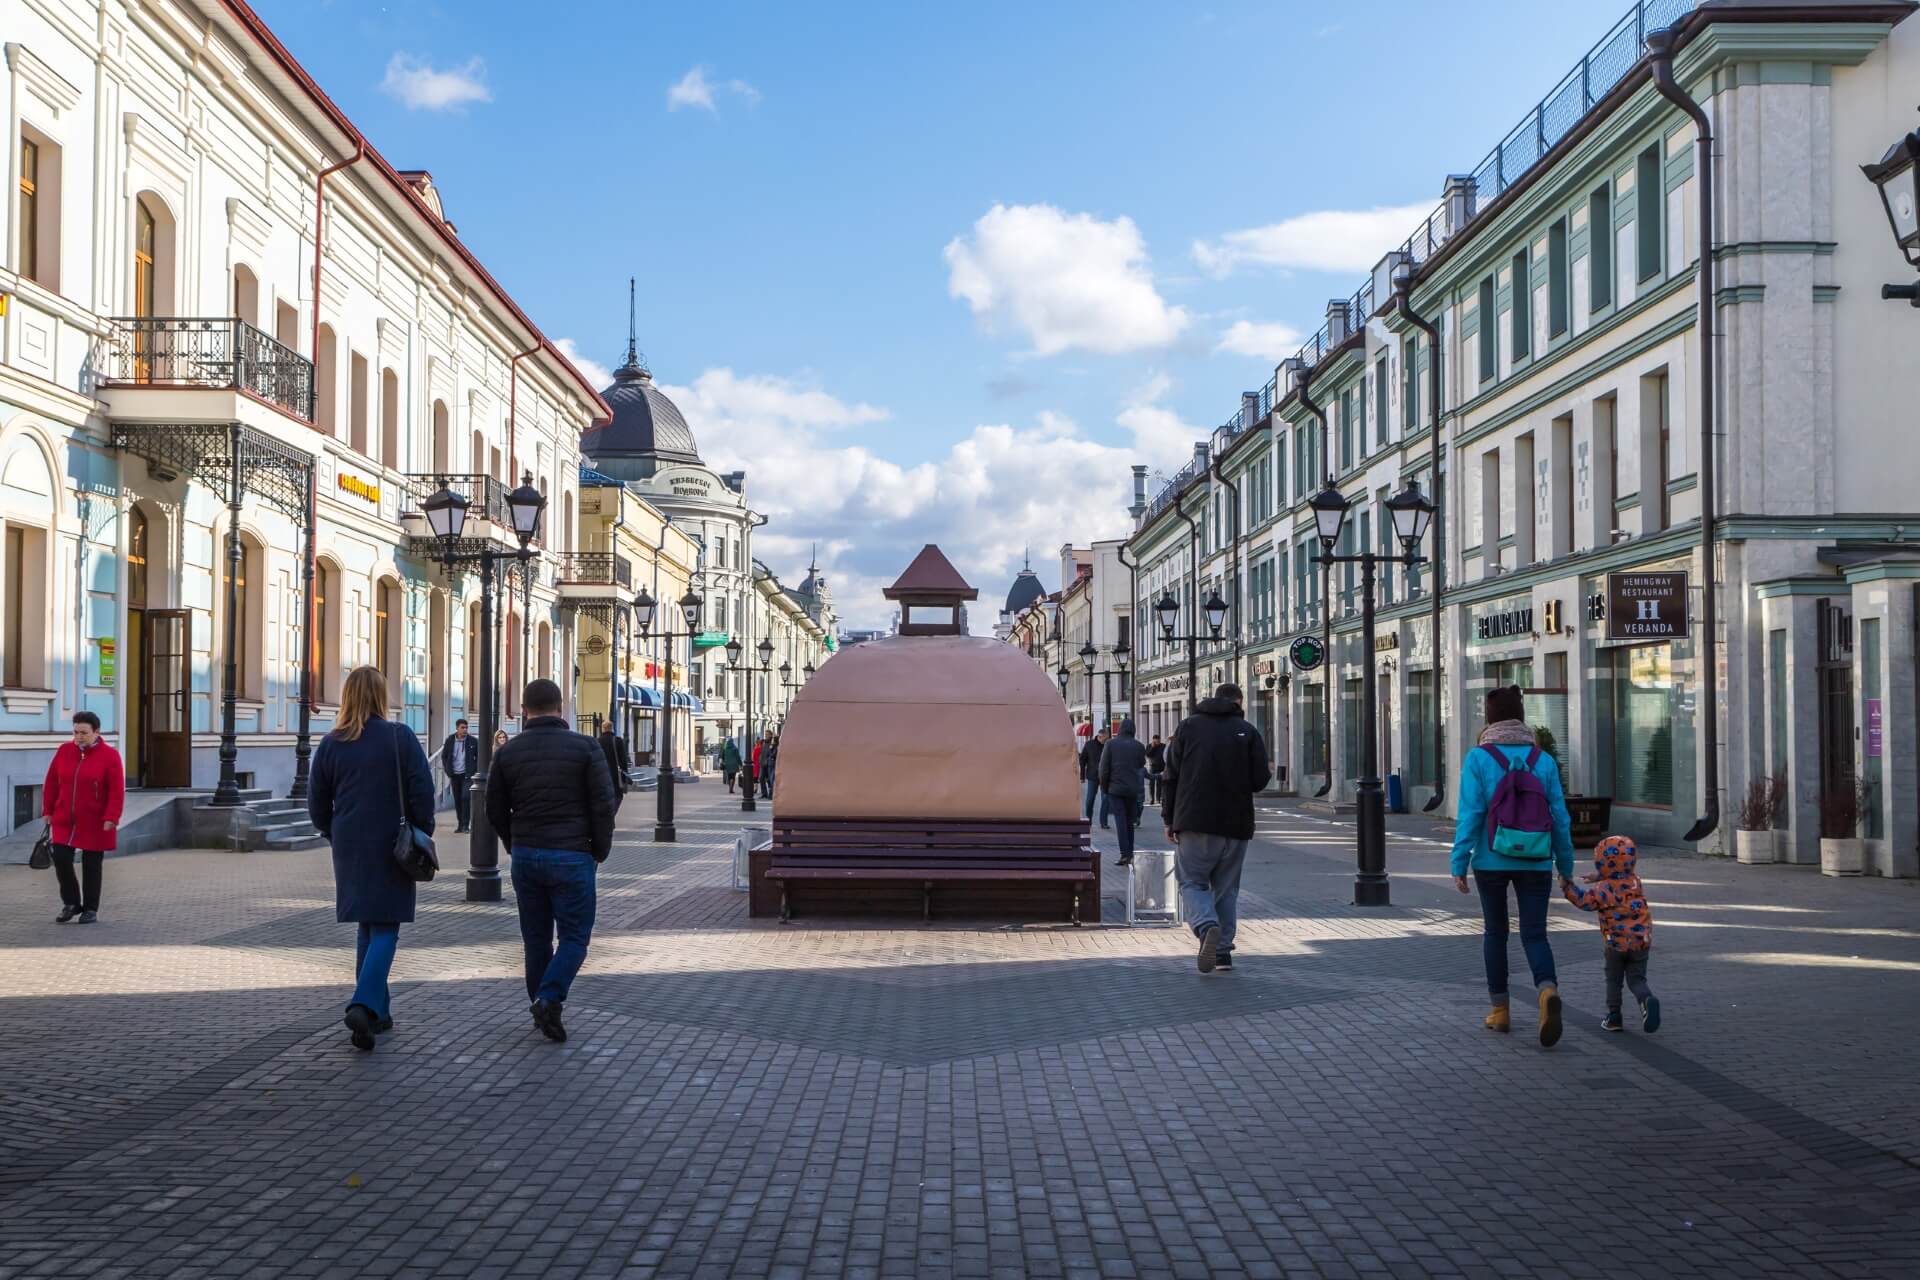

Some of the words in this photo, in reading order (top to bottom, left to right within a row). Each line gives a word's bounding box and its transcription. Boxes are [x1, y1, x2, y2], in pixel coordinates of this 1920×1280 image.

[1624, 577, 1672, 586] HEMINGWAY
[1622, 588, 1673, 597] RESTAURANT
[1636, 600, 1661, 620] H
[1478, 608, 1533, 639] HEMINGWAY
[1543, 600, 1562, 634] H
[1587, 592, 1606, 621] RES
[1624, 623, 1674, 633] VERANDA
[1293, 638, 1305, 648] TOP
[1308, 638, 1321, 648] HOP
